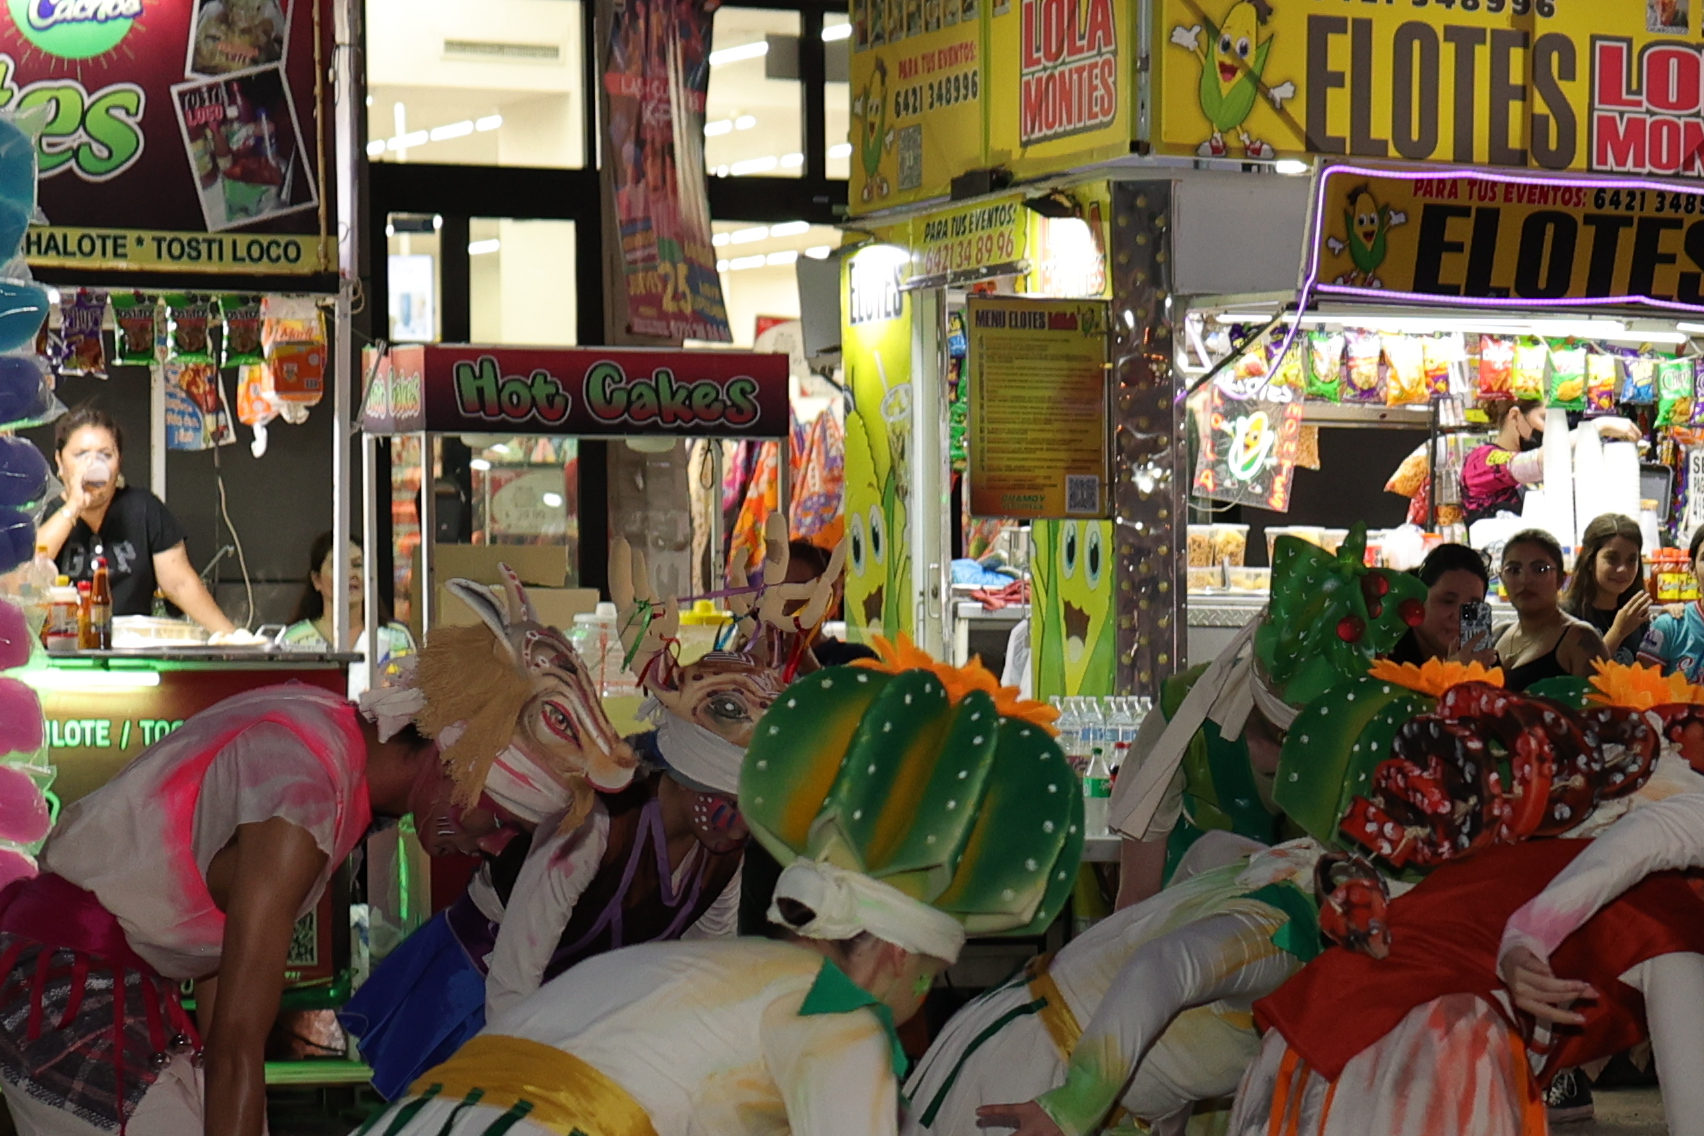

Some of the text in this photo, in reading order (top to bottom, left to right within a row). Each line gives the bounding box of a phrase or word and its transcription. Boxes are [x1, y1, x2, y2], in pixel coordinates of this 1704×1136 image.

[1021, 0, 1117, 71] LOLA
[894, 68, 979, 120] 6421 348996
[1020, 52, 1117, 142] MONTES
[1303, 14, 1577, 170] ELOTES
[1413, 179, 1459, 200] PARA
[1467, 180, 1498, 202] TUS
[1503, 184, 1587, 208] EVENTOS:
[1593, 187, 1646, 212] 6421
[923, 206, 1017, 243] PARA TUS EVENTOS:
[21, 232, 303, 264] HALOTE TOSTI LOCO
[975, 310, 1007, 329] MENU
[1009, 311, 1047, 330] ELOTES
[453, 355, 762, 427] Hot Cakes
[44, 719, 111, 748] LOTE
